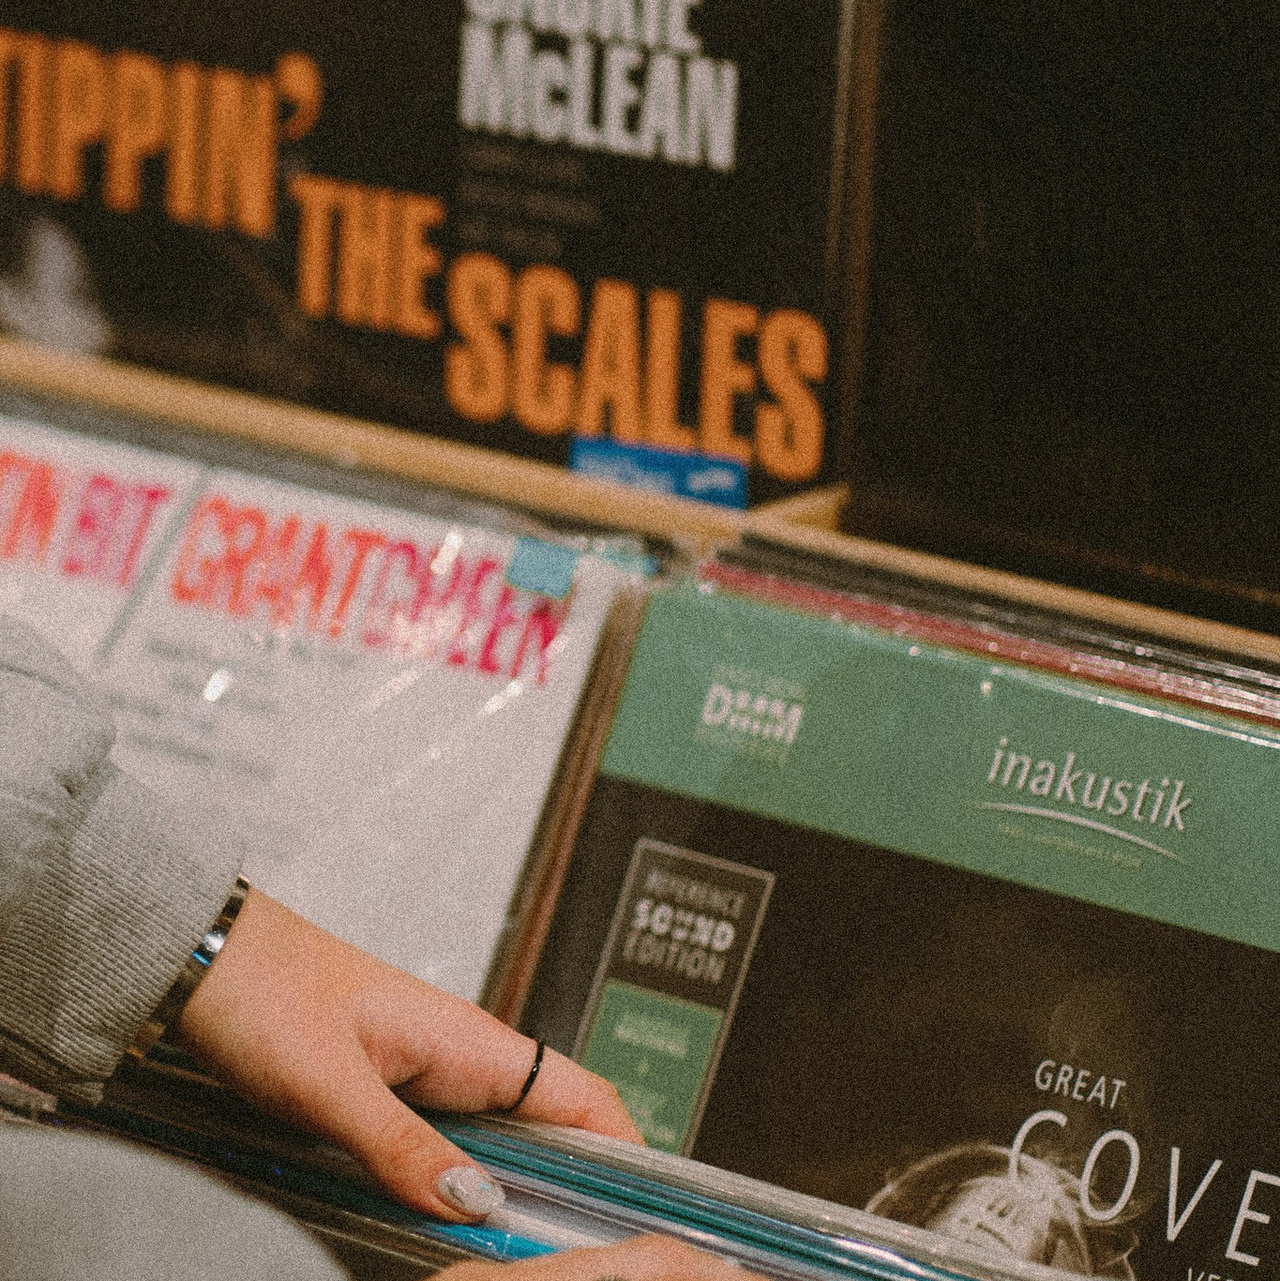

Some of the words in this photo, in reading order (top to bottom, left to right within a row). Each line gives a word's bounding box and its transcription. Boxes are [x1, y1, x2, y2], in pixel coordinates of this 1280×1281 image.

[459, 19, 738, 170] McLEAN
[286, 173, 444, 338] THE
[446, 254, 828, 482] SCALES
[170, 494, 389, 640] GRANT
[986, 735, 1194, 832] inakustik
[623, 930, 727, 984] EDITION
[631, 898, 736, 952] SOUND
[1034, 1059, 1127, 1110] GREAT
